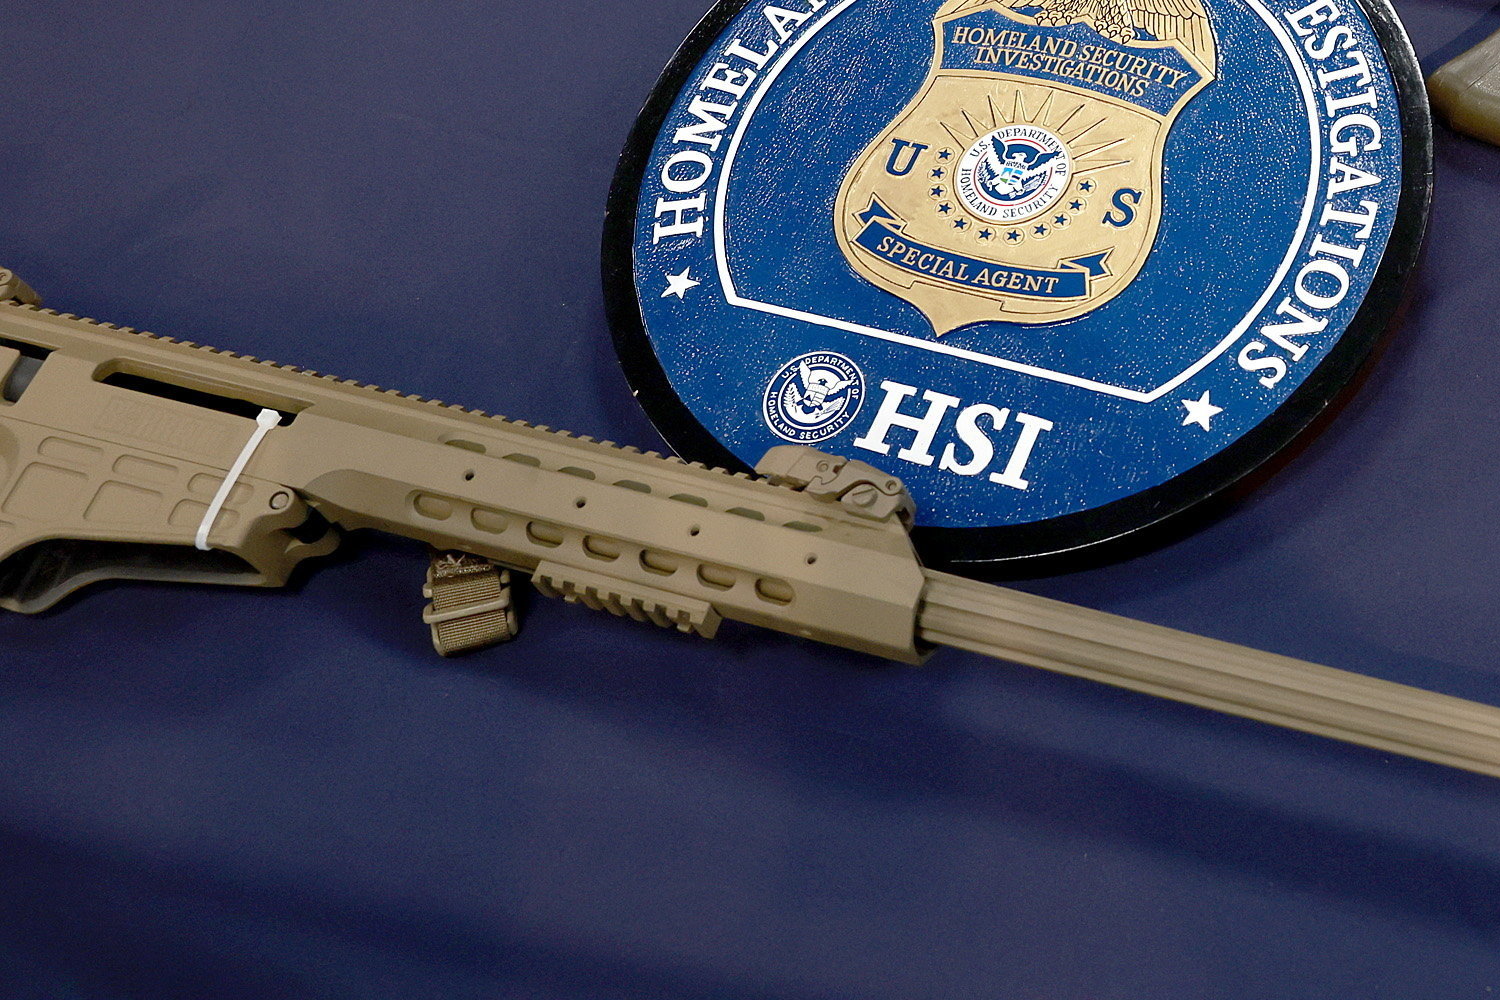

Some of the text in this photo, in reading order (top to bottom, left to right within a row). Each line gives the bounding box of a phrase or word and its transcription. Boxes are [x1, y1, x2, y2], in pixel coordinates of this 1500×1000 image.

[952, 27, 1191, 89] HOMELAND SECURITY
[974, 47, 1150, 98] INVESTIGATIONS
[885, 138, 928, 177] U
[997, 127, 1066, 160] DEPARTMENT
[1055, 162, 1067, 177] OF
[960, 168, 1059, 219] HOMELAND SECURITY
[1102, 188, 1142, 227] S
[877, 236, 1060, 293] SPECIAL AGENT
[805, 355, 859, 386] DEPARTMENT
[851, 388, 860, 400] OF
[767, 391, 850, 440] HOMELAND SECURITY
[853, 380, 1054, 490] HSI
